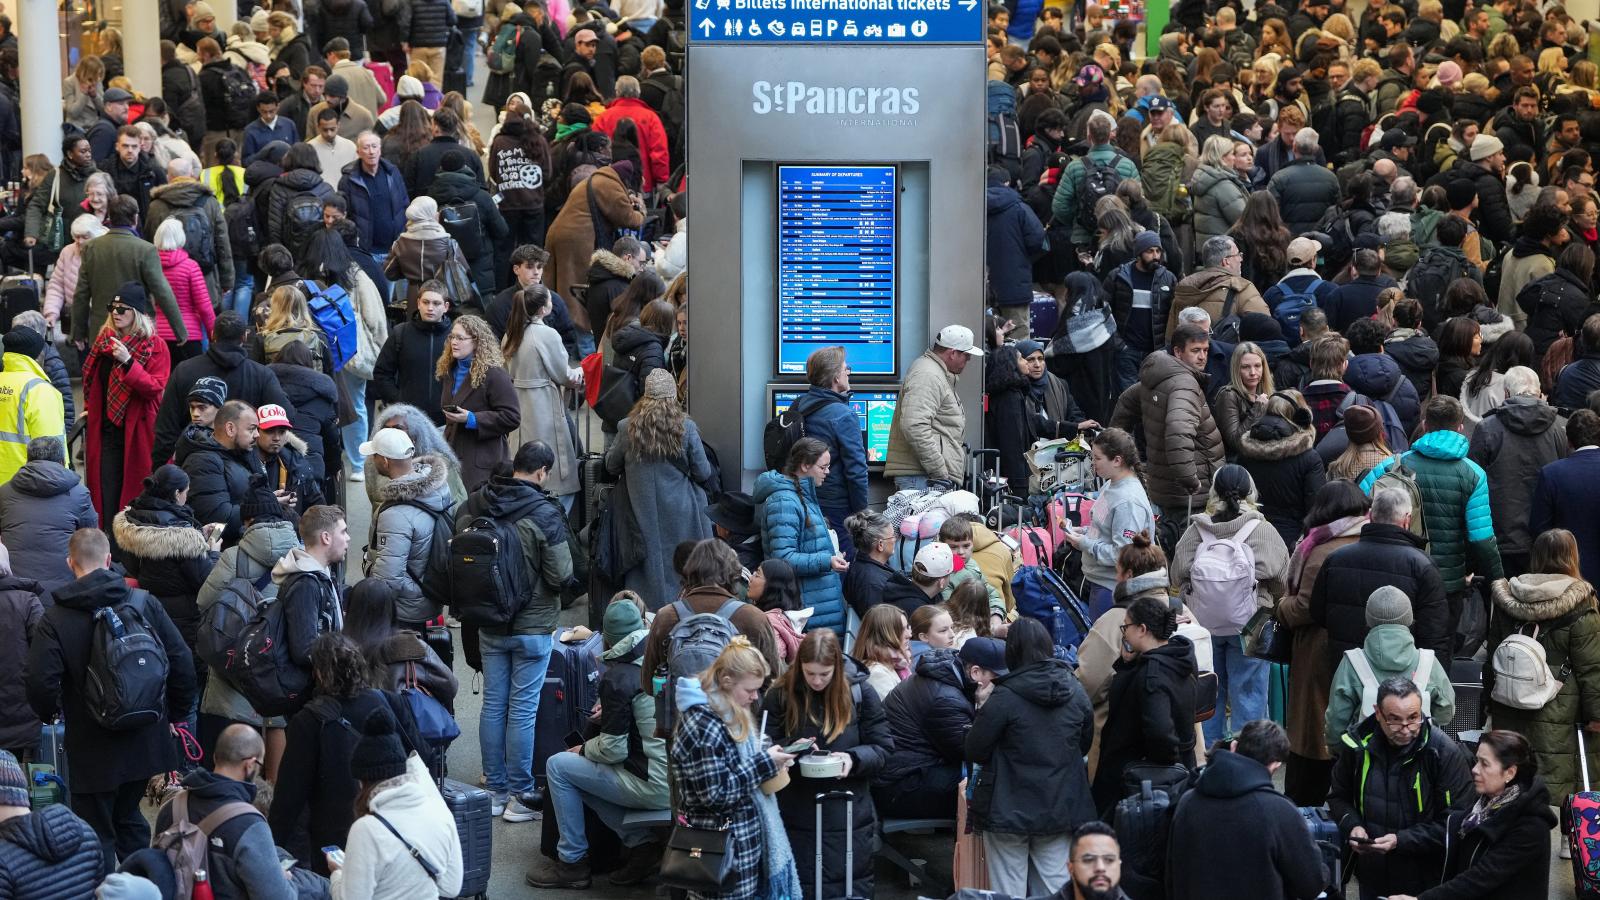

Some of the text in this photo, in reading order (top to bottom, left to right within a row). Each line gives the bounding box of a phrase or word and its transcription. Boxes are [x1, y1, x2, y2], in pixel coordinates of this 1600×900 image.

[735, 0, 786, 10] Billets
[897, 0, 950, 10] tickets
[260, 406, 285, 418] Coke
